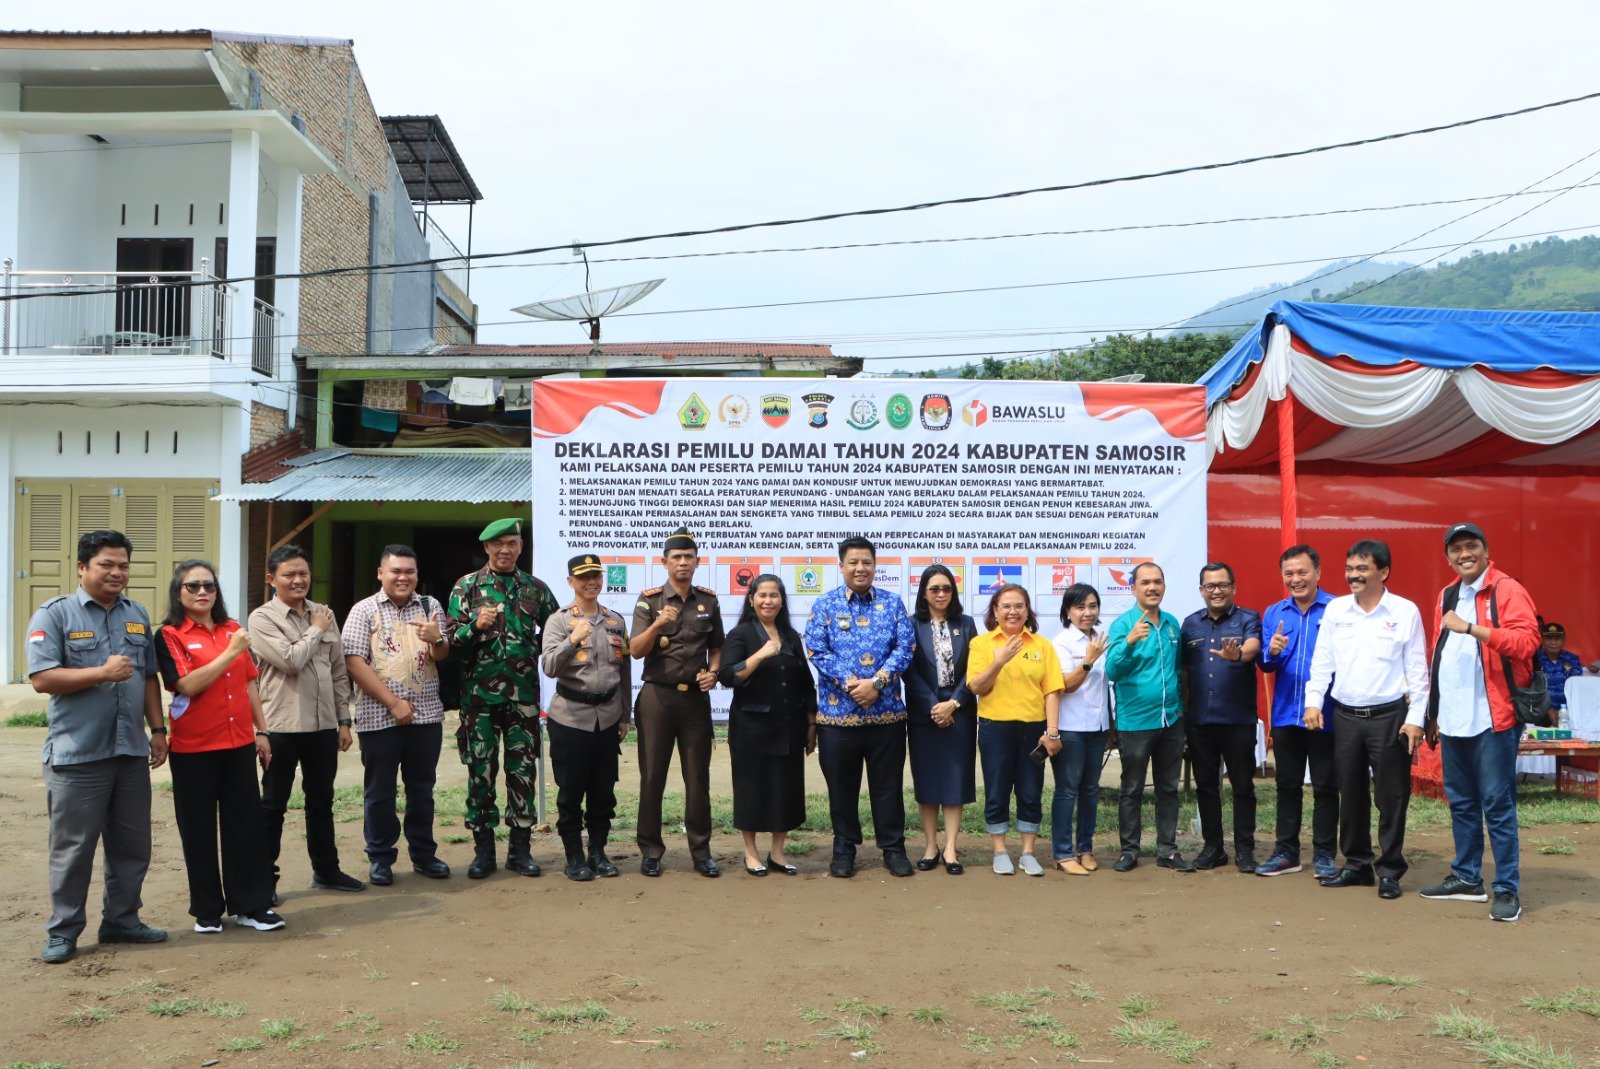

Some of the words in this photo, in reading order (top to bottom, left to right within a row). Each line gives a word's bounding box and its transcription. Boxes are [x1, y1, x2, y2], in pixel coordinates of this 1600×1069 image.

[992, 406, 1065, 418] BAWASLU
[555, 442, 669, 458] DEKLARASI
[677, 443, 753, 458] PEMILU
[762, 443, 826, 458] DAMAI
[833, 443, 904, 459] TAHUN
[912, 444, 959, 459] 2024
[967, 444, 1088, 460] KABUPATEN
[1095, 445, 1185, 461] SAMOSIR
[560, 463, 590, 472] KAMI
[594, 463, 667, 472] PELAKSANA
[671, 463, 695, 472] DAN
[700, 463, 754, 472] PESERTA
[758, 464, 802, 472] PEMILU
[807, 464, 848, 473] TAHUN
[853, 464, 881, 473] 2024
[885, 464, 957, 473] KABUPATEN
[962, 464, 1016, 473] SAMOSIR
[1020, 464, 1069, 474] DENGAN
[1074, 465, 1089, 474] INI
[1094, 465, 1173, 474] MENYATAKAN
